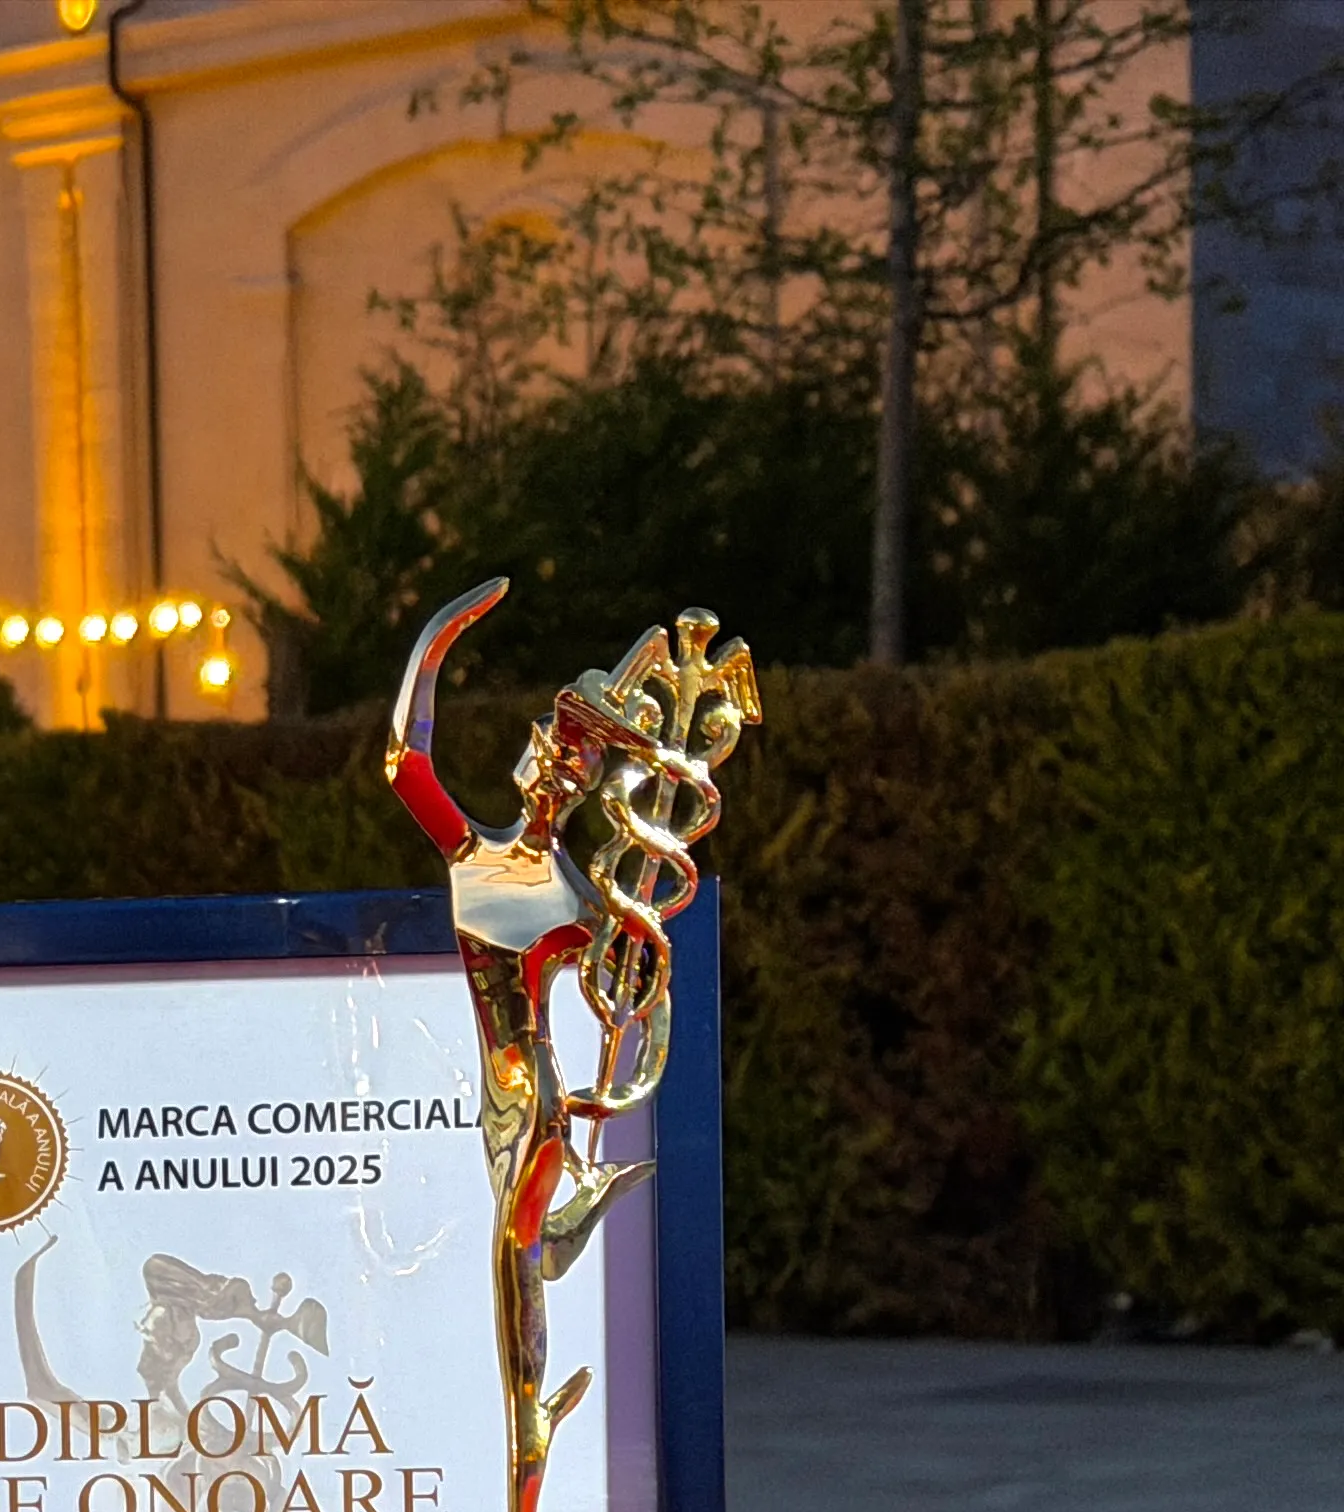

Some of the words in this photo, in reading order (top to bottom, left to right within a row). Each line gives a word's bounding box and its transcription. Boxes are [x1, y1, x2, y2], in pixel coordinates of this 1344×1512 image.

[98, 1105, 237, 1139] MARCA
[24, 1125, 53, 1195] ANULUI
[98, 1160, 125, 1192] A
[134, 1156, 280, 1191] ANULUI
[290, 1154, 382, 1188] 2025
